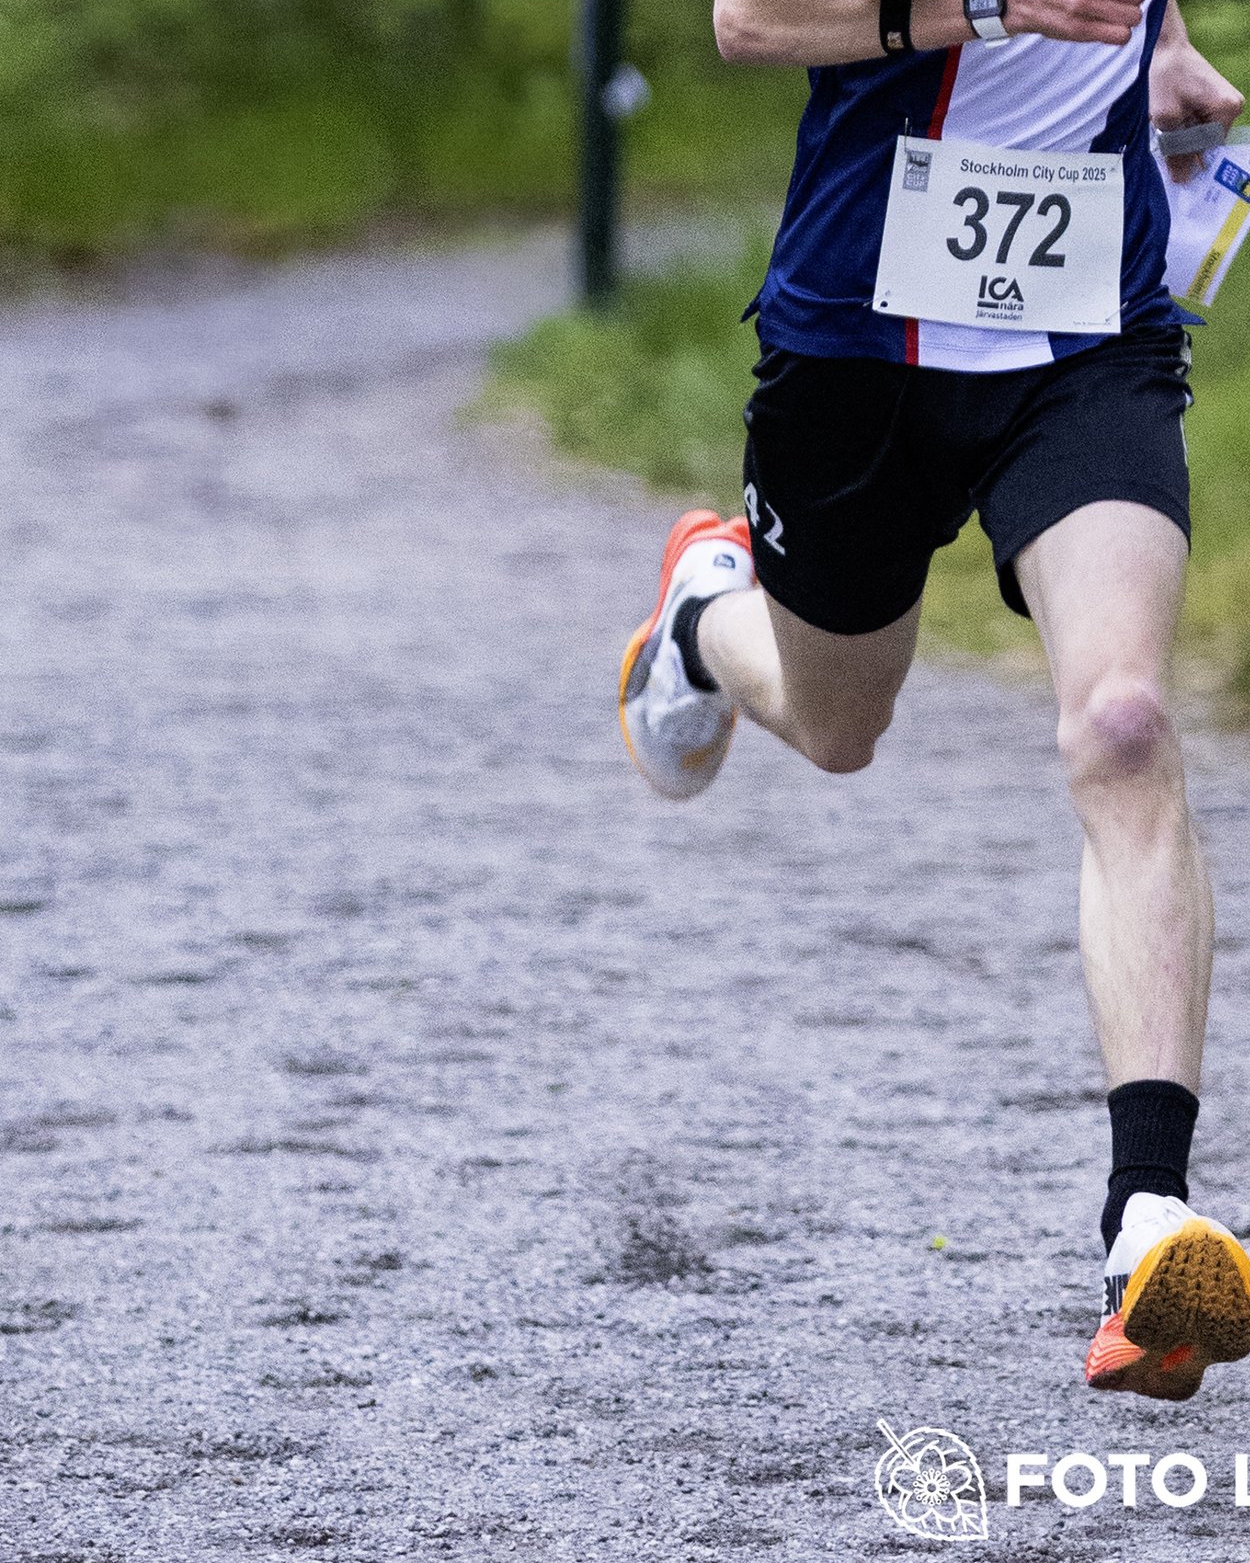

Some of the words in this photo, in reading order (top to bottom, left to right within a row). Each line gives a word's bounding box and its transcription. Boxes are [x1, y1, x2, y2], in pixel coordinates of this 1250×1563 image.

[960, 158, 1029, 178] Stockholm
[1032, 165, 1055, 182] City
[1058, 166, 1080, 182] Cup
[1082, 167, 1107, 181] 2025
[946, 186, 1072, 268] 372
[978, 275, 1024, 302] ICA
